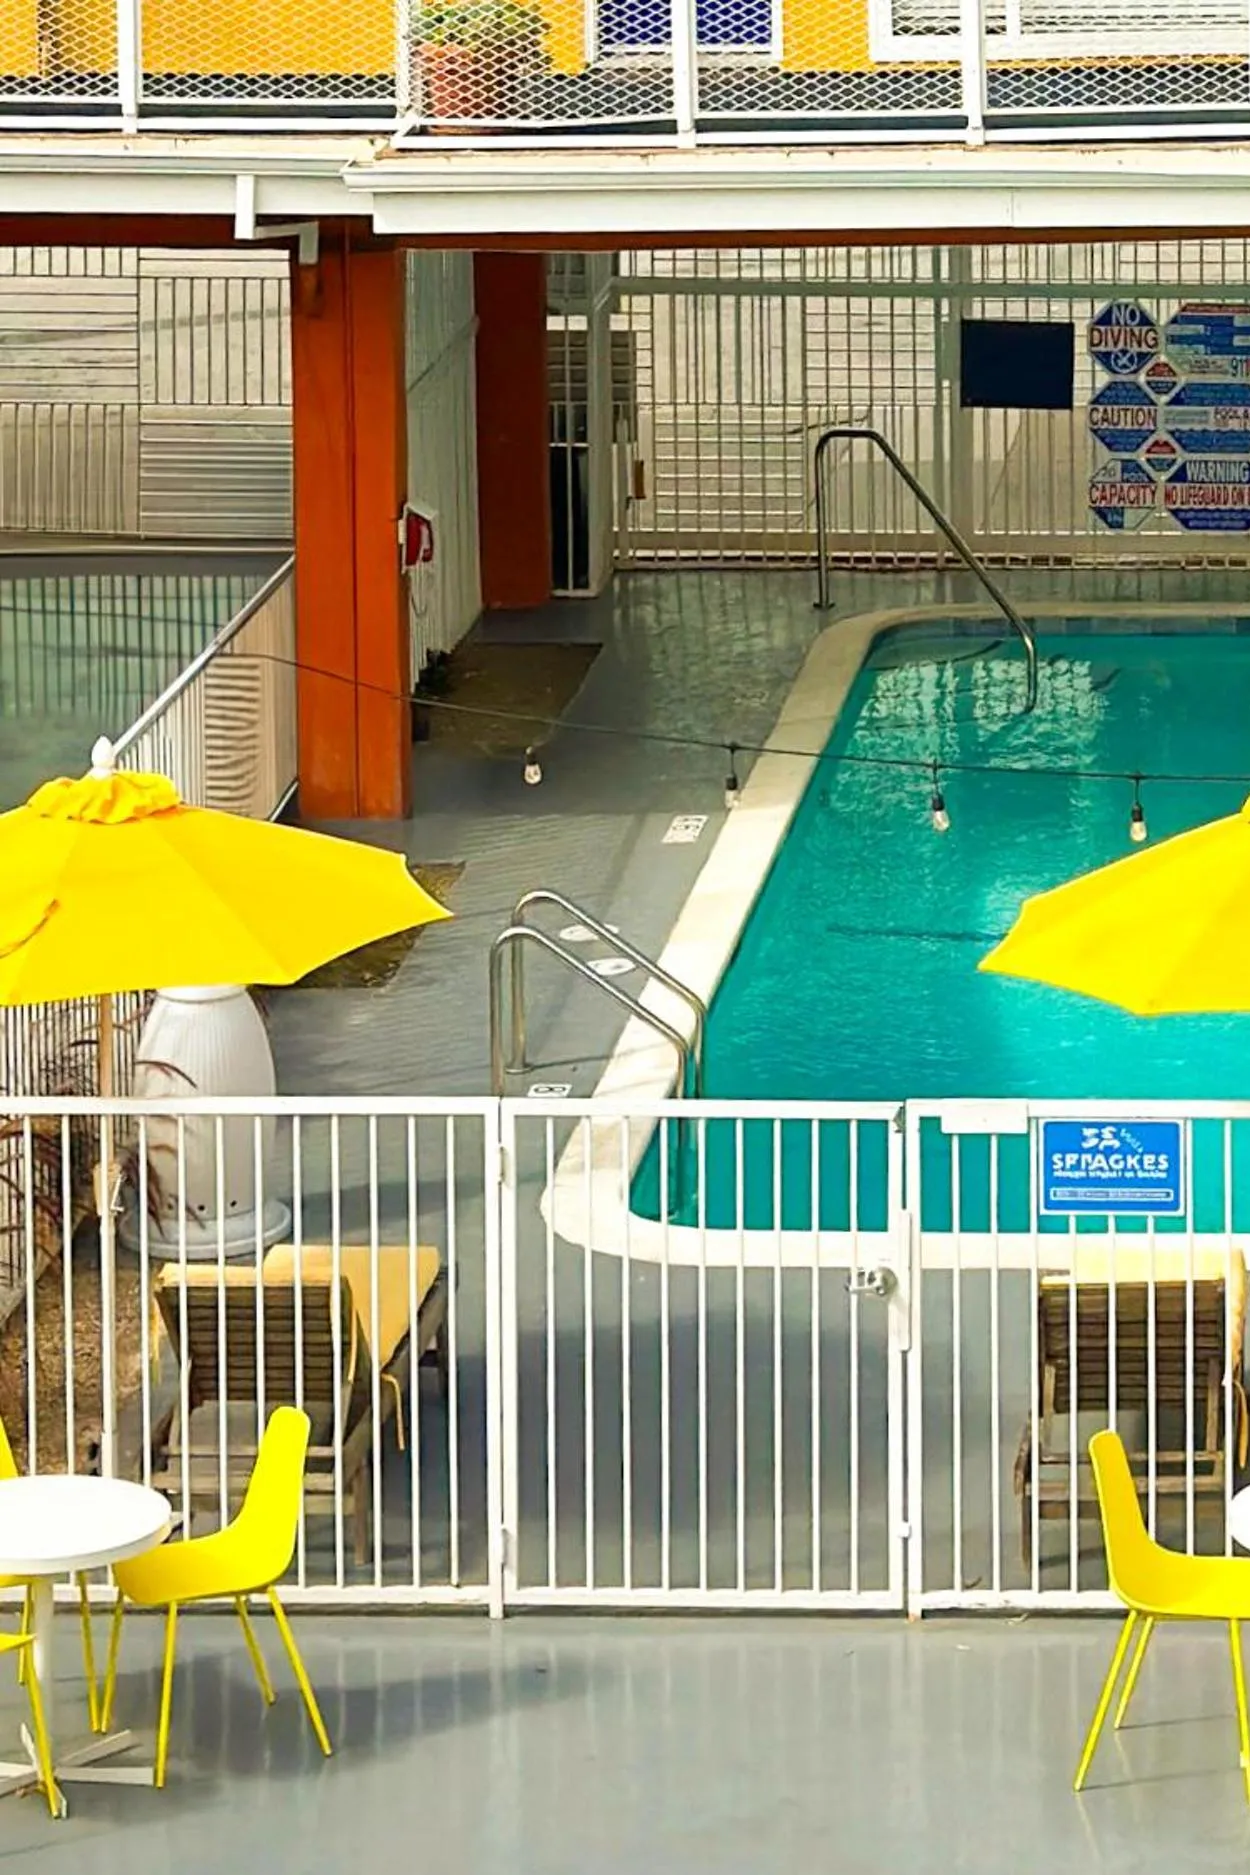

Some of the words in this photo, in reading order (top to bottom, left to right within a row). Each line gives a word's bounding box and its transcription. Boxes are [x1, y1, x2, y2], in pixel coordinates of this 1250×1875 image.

[1111, 304, 1140, 326] NO
[1090, 327, 1159, 349] DIVING
[1089, 407, 1158, 427] CAUTION
[1185, 461, 1250, 482] WARNING
[1089, 483, 1158, 505] CAPACITY
[1163, 485, 1178, 505] NO
[1180, 485, 1229, 506] LIFEGUARD
[1231, 485, 1244, 506] ON
